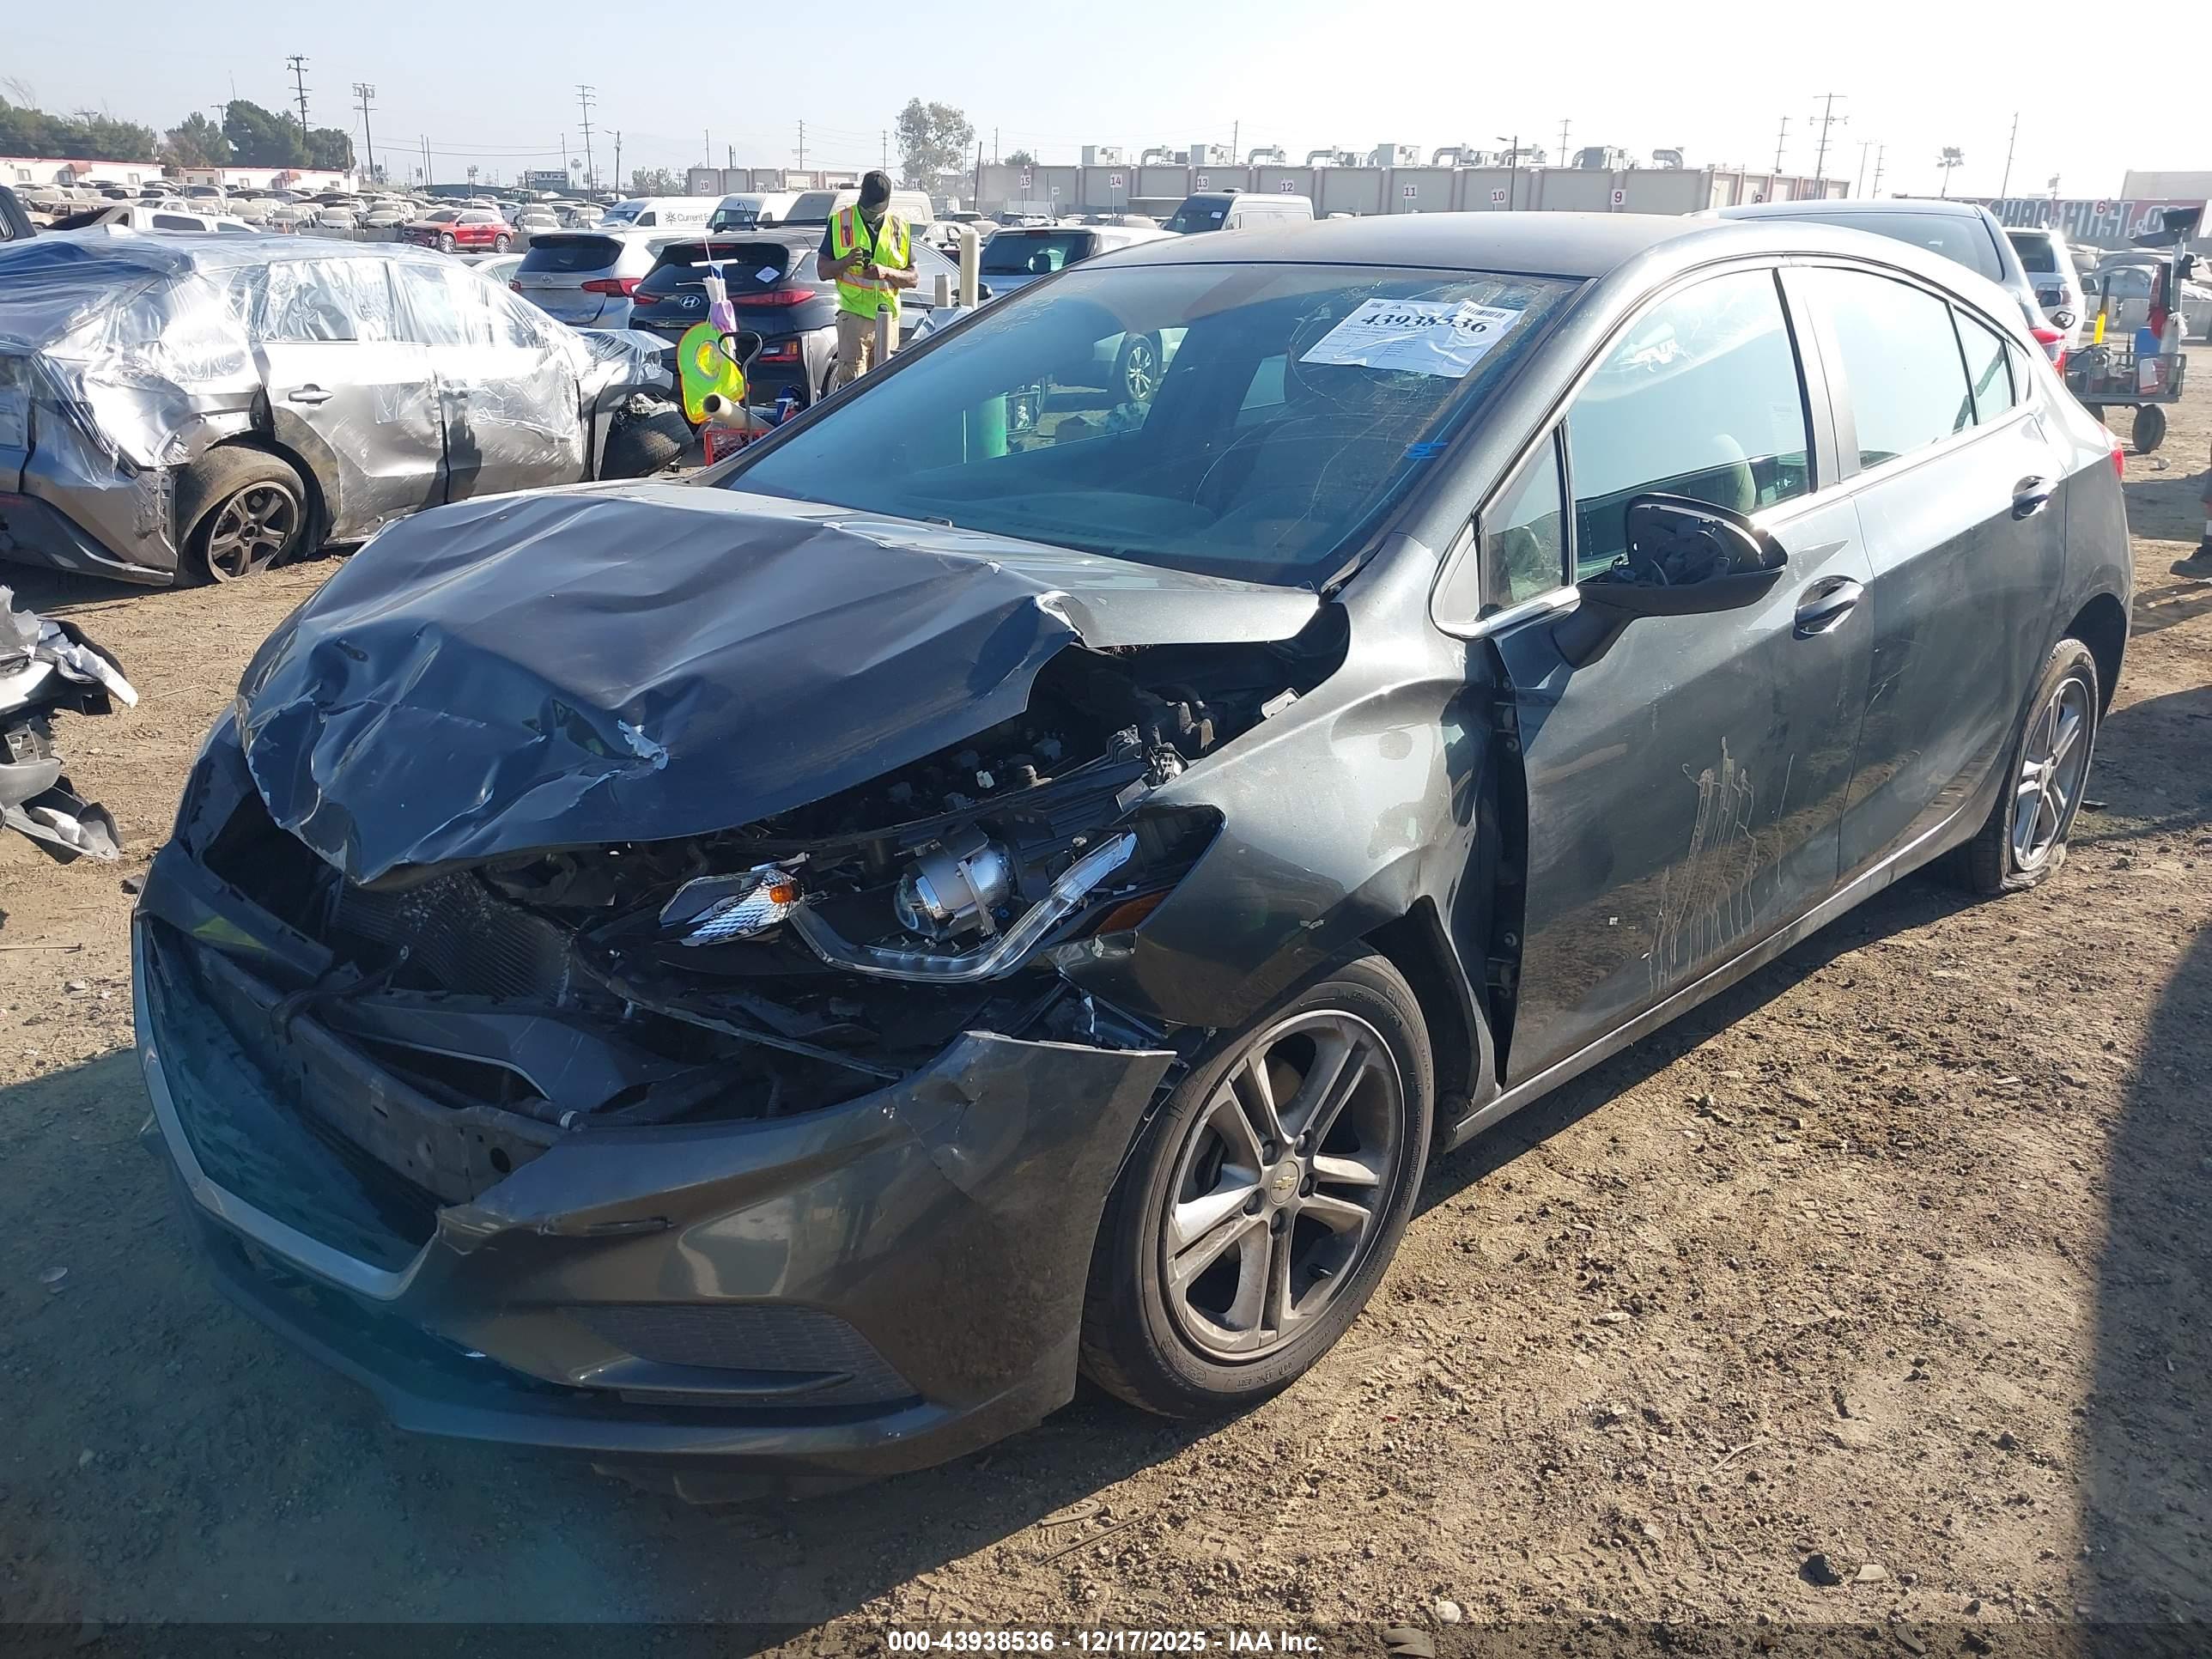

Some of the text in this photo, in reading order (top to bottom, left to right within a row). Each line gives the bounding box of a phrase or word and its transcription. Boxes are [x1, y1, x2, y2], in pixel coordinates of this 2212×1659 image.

[700, 181, 709, 190] 19
[1020, 177, 1030, 186] 15
[1110, 177, 1121, 186] 14
[1197, 179, 1208, 188] 13
[1281, 183, 1293, 192] 12
[1403, 187, 1416, 197] 11
[1492, 191, 1505, 202] 10
[1613, 191, 1623, 204] 9
[2096, 200, 2106, 214] 6
[677, 213, 703, 222] Current
[1360, 313, 1492, 333] 43938536
